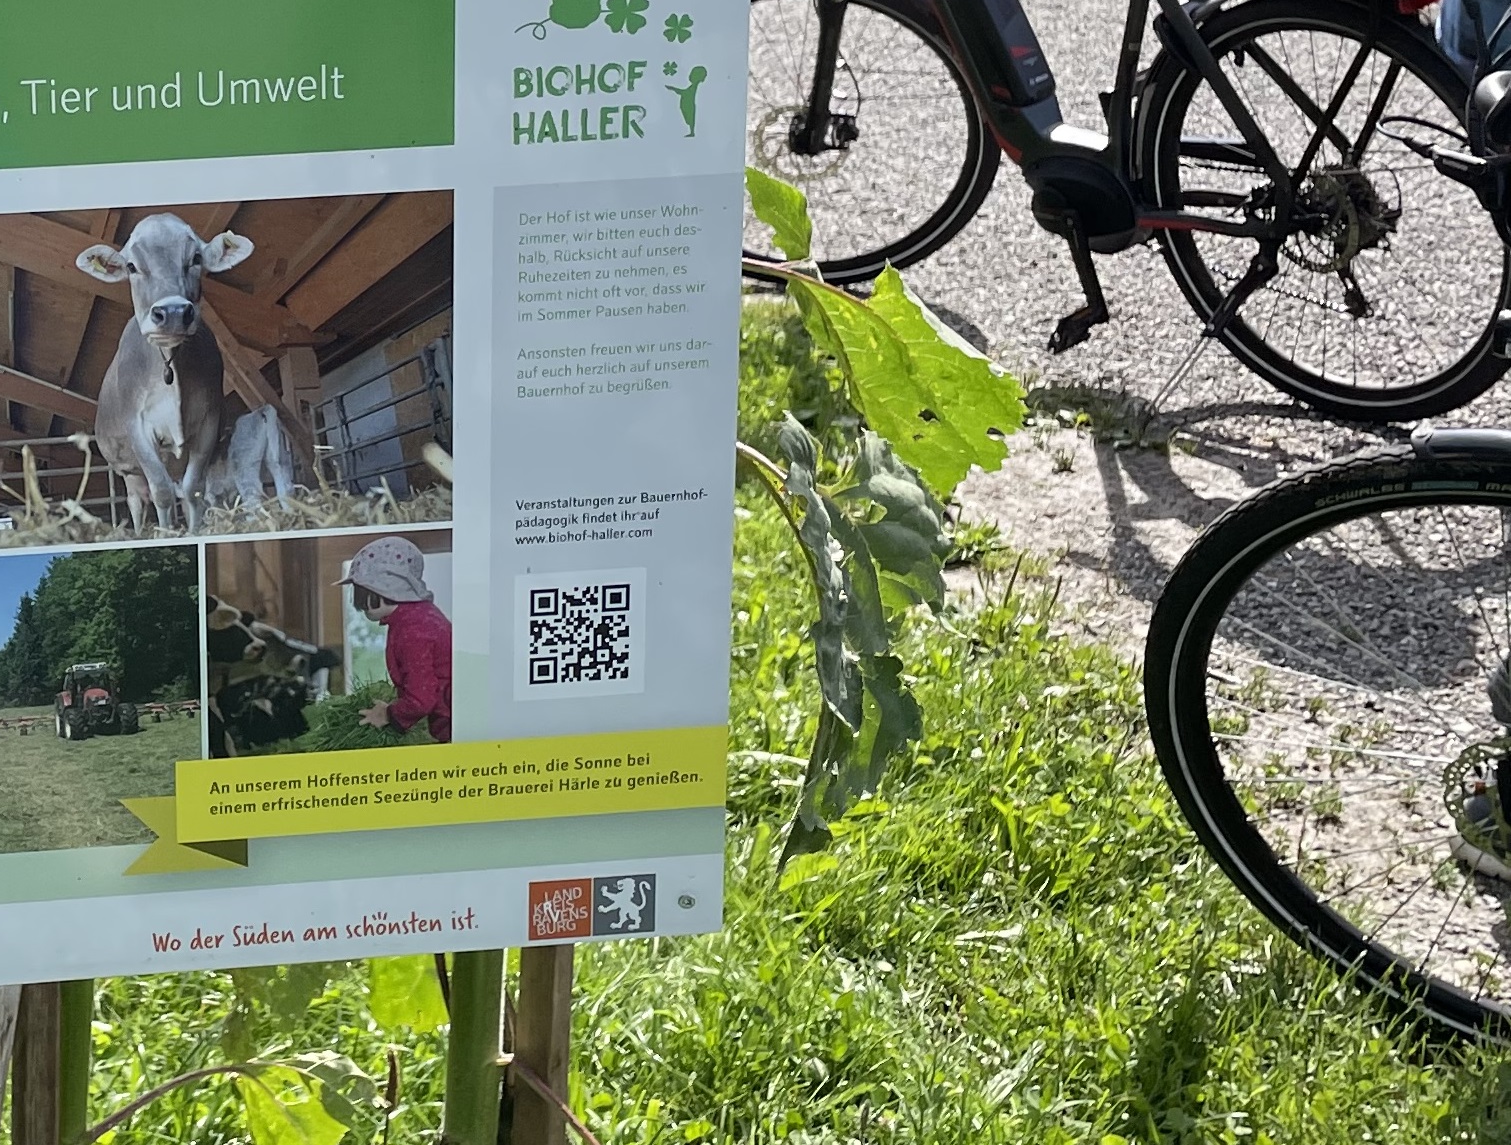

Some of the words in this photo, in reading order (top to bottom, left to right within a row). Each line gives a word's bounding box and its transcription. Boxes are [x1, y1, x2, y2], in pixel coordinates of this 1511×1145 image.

[19, 78, 98, 115] Tier
[112, 70, 181, 111] und
[197, 63, 345, 106] Umwelt
[513, 59, 648, 99] BIOHOF
[512, 104, 646, 145] HALLER
[518, 212, 542, 226] Der
[546, 209, 572, 224] Hof
[573, 209, 590, 223] ist
[593, 208, 616, 221] wie
[620, 208, 657, 220] unser
[660, 203, 704, 217] Wohn-
[571, 228, 594, 242] wir
[595, 227, 635, 241] bitten
[638, 223, 670, 239] euch
[673, 222, 702, 236] des-
[553, 245, 617, 262] Rücksicht
[620, 243, 643, 259] auf
[645, 245, 690, 257] unsere
[514, 496, 614, 511] Veranstaltungen
[617, 495, 637, 505] zur
[639, 487, 708, 504] Bauernhof-
[514, 512, 578, 531] pädagogik
[581, 510, 617, 524] findet
[620, 511, 636, 522] ihr
[640, 507, 660, 521] auf
[514, 527, 653, 545] www.biohof-haller.com
[208, 780, 230, 795] An
[235, 778, 301, 793] unserem
[306, 771, 390, 788] Hoffenster
[395, 767, 437, 782] laden
[441, 764, 467, 779] wir
[470, 761, 507, 777] euch
[512, 759, 540, 775] ein,
[545, 757, 569, 772] die
[573, 756, 622, 770] Sonne
[626, 751, 650, 767] bei
[209, 800, 256, 815] einem
[261, 792, 368, 812] erfrischenden
[373, 786, 453, 804] Seezüngle
[457, 784, 484, 798] der
[487, 778, 553, 796] Brauerei
[558, 775, 600, 792] Härle
[603, 775, 622, 789] zu
[626, 769, 703, 791] genießen.
[544, 886, 583, 903] LAND
[532, 906, 589, 926] RAVENS
[533, 899, 575, 916] KREIS
[151, 931, 182, 953] Wo
[189, 927, 225, 950] der
[231, 921, 295, 947] Süden
[302, 925, 337, 941] am
[345, 910, 442, 939] schönsten
[450, 906, 479, 931] ist.
[536, 920, 577, 936] BURG
